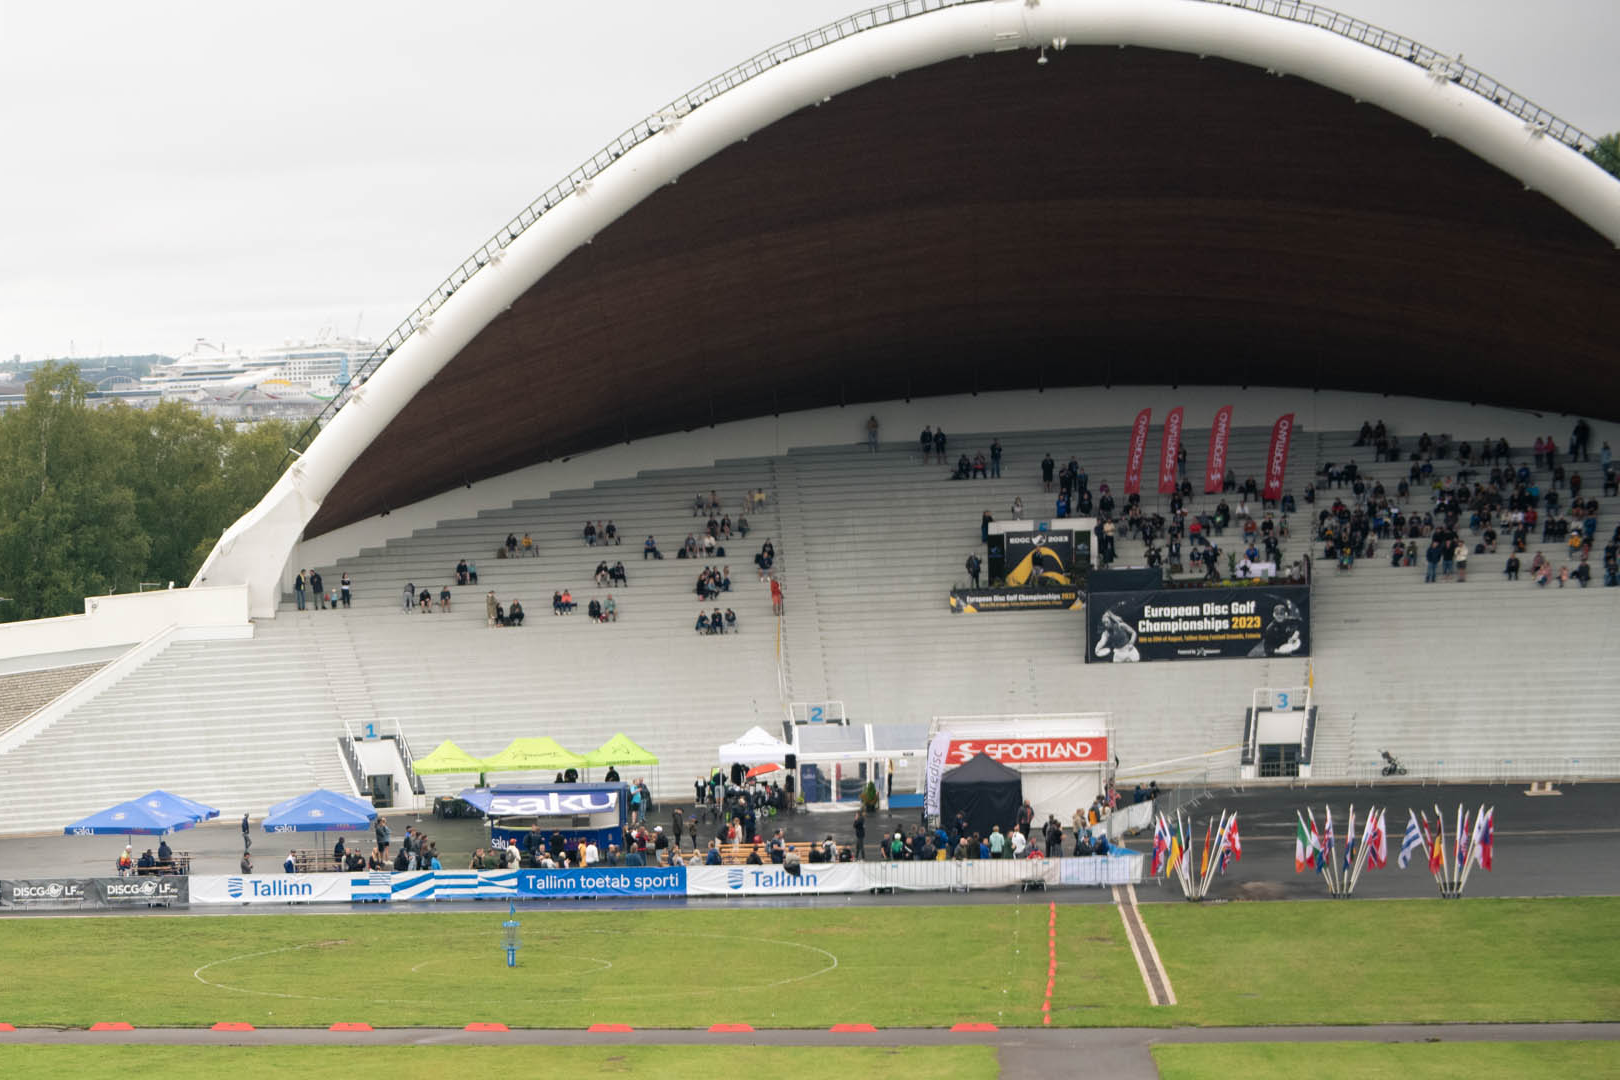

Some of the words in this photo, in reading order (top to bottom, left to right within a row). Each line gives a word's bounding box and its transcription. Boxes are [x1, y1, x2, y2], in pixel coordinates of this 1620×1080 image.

[1131, 415, 1148, 470] SPORTLAND
[1165, 413, 1180, 469] SPORTLAND
[1212, 412, 1229, 468] SPORTLAND
[1271, 420, 1289, 475] SPORTLAND
[1143, 604, 1200, 619] European
[1202, 603, 1229, 616] Disc
[1231, 601, 1256, 614] Golf
[1138, 616, 1229, 634] Championships
[1231, 615, 1262, 629] 2023
[1276, 693, 1289, 709] 3
[811, 707, 824, 722] 2
[365, 723, 377, 738] 1
[984, 741, 1092, 760] SPORTLAND
[928, 750, 943, 808] puredisc
[489, 792, 618, 815] saku
[72, 826, 95, 836] saku
[274, 824, 297, 833] saku
[491, 837, 509, 850] saku
[250, 879, 313, 897] Tallinn
[526, 874, 576, 889] Tallinn
[580, 873, 630, 888] toetab
[634, 872, 679, 892] sporti
[750, 871, 818, 888] Tallinn
